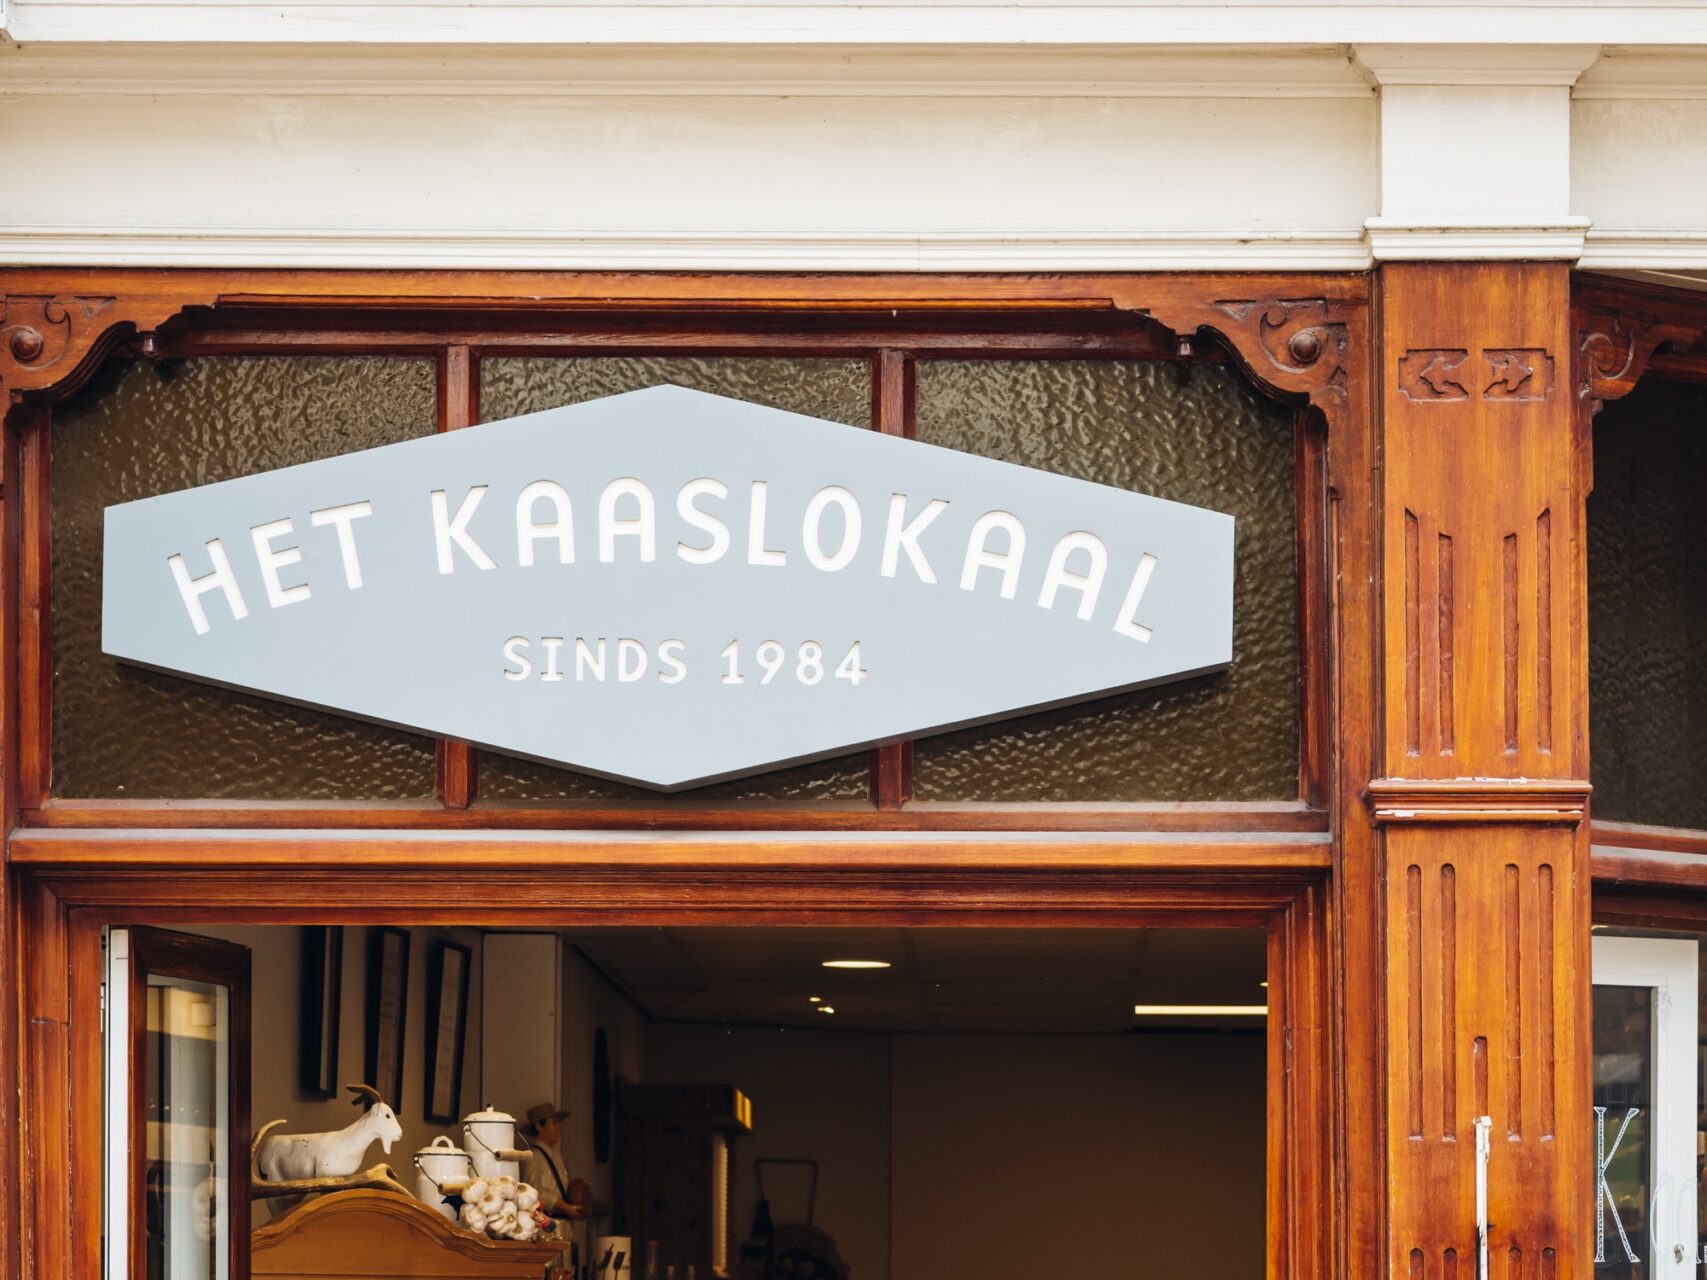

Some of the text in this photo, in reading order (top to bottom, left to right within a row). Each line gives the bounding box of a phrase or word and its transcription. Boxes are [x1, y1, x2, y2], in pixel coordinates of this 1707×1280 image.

[166, 476, 1157, 644] HET KAASLOKAAL
[502, 636, 867, 686] SINDS 1984
